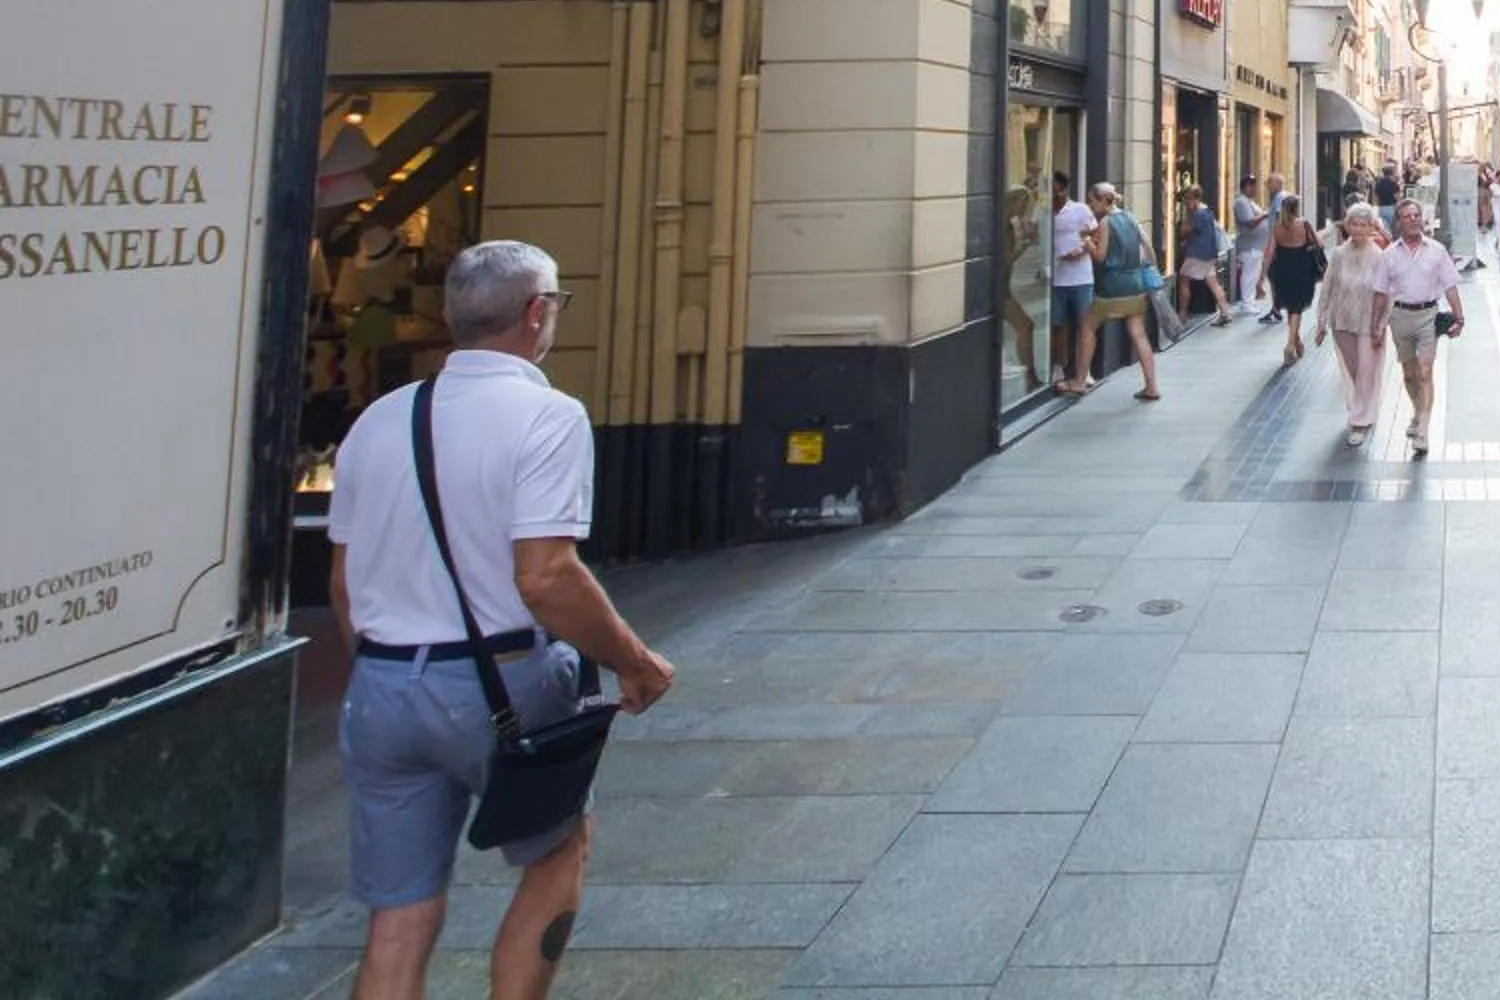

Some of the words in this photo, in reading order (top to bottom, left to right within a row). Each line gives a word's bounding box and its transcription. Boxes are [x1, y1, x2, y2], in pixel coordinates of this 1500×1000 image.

[0, 94, 213, 143] ENTRALE
[34, 550, 153, 599] CONTINUATO
[58, 586, 119, 627] 20.30
